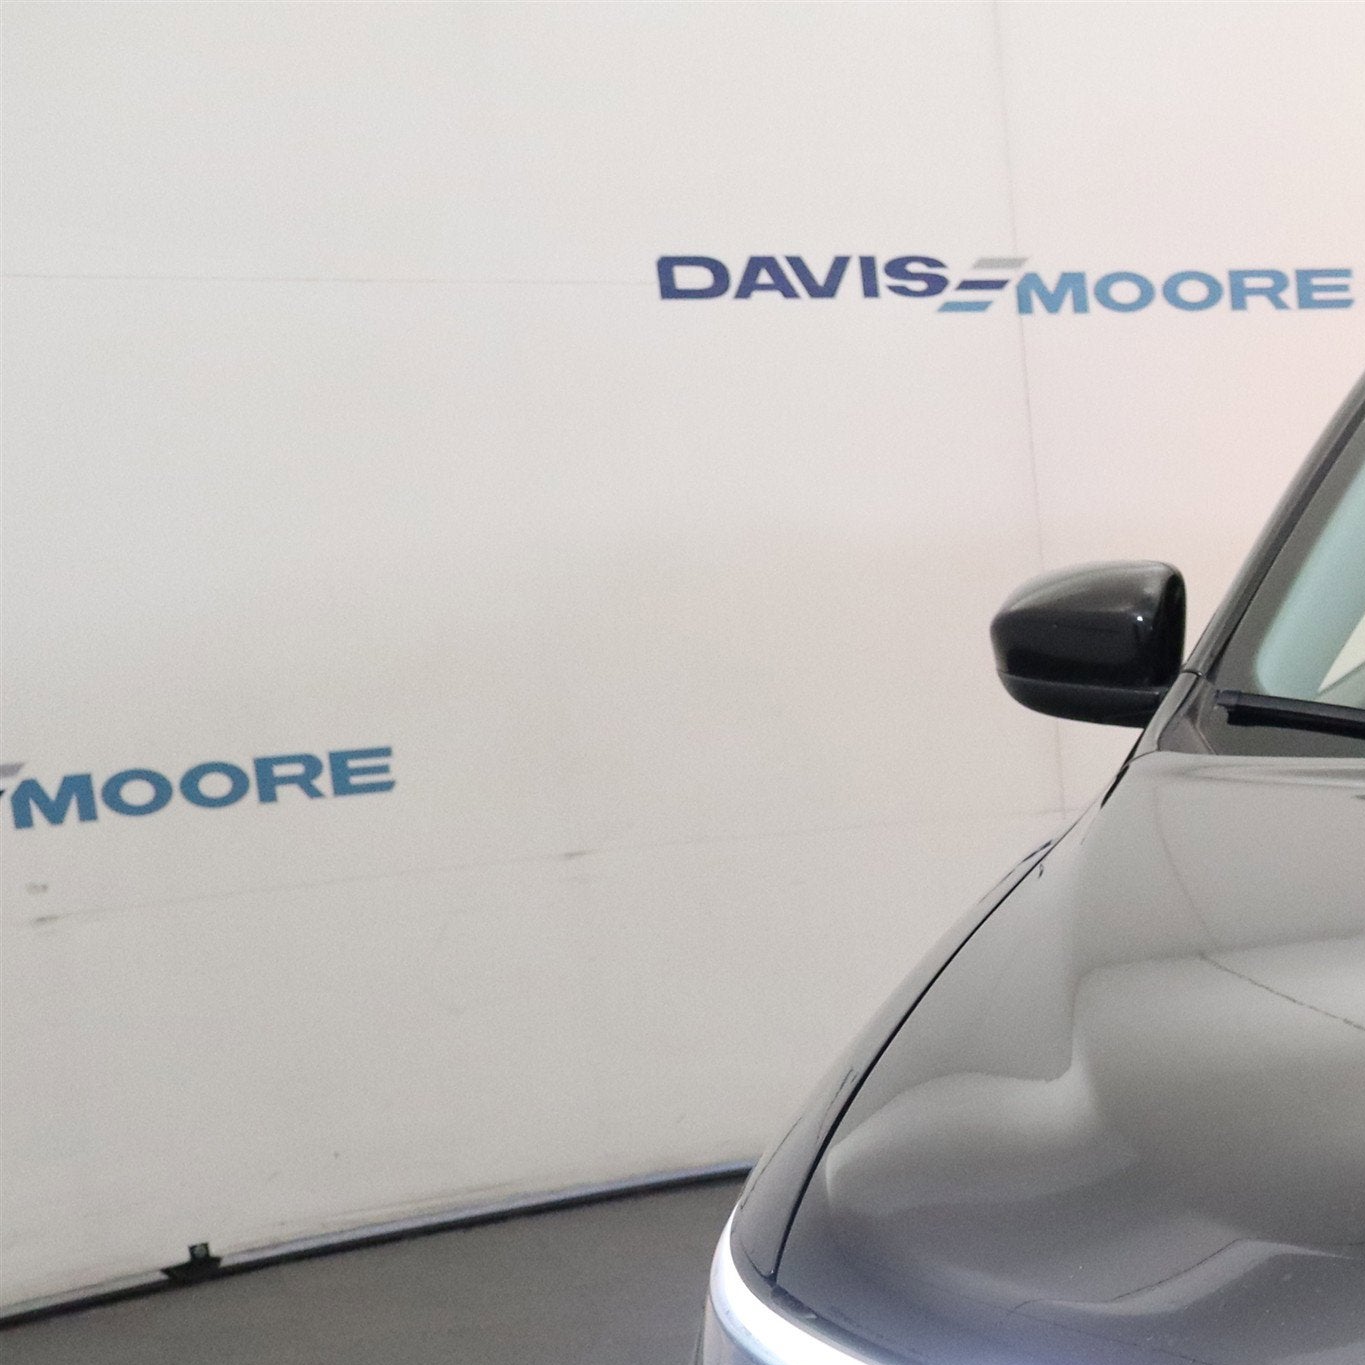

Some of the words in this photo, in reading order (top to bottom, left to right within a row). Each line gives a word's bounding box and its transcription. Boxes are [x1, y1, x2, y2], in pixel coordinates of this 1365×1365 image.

[656, 255, 949, 300] DAVIS
[1016, 268, 1355, 315] MOORE
[10, 746, 395, 829] MOORE
